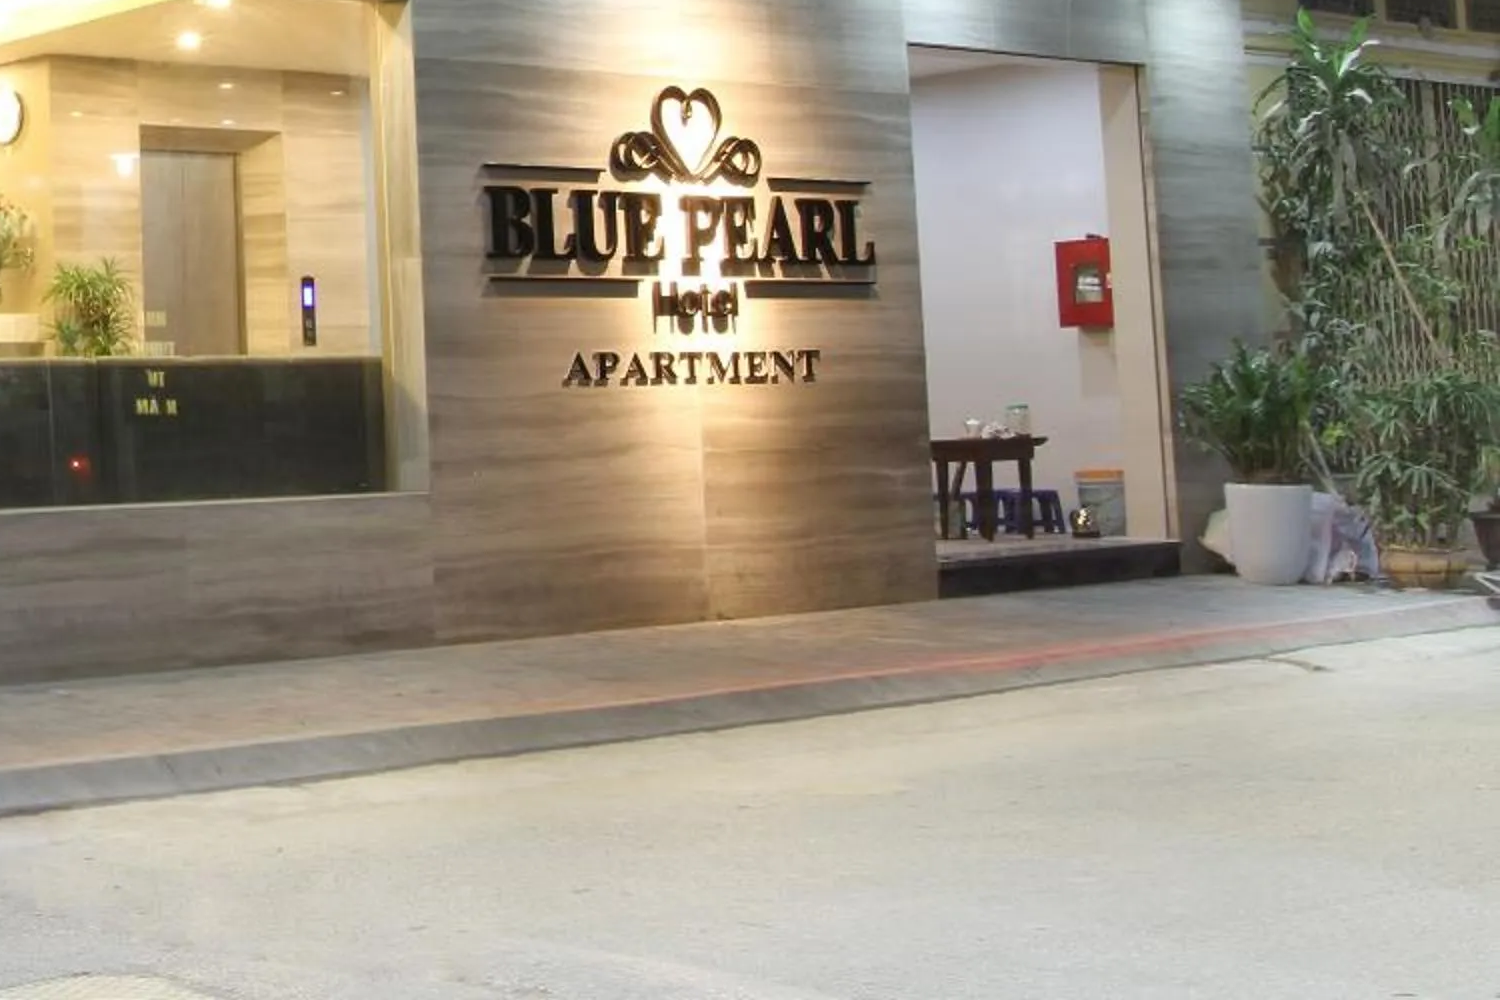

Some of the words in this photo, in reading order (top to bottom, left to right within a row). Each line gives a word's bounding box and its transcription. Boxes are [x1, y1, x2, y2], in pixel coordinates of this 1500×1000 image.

[484, 186, 666, 262] BLUE
[679, 195, 877, 267] PEARL
[652, 280, 739, 318] Hotel
[562, 350, 821, 387] APARTMENT
